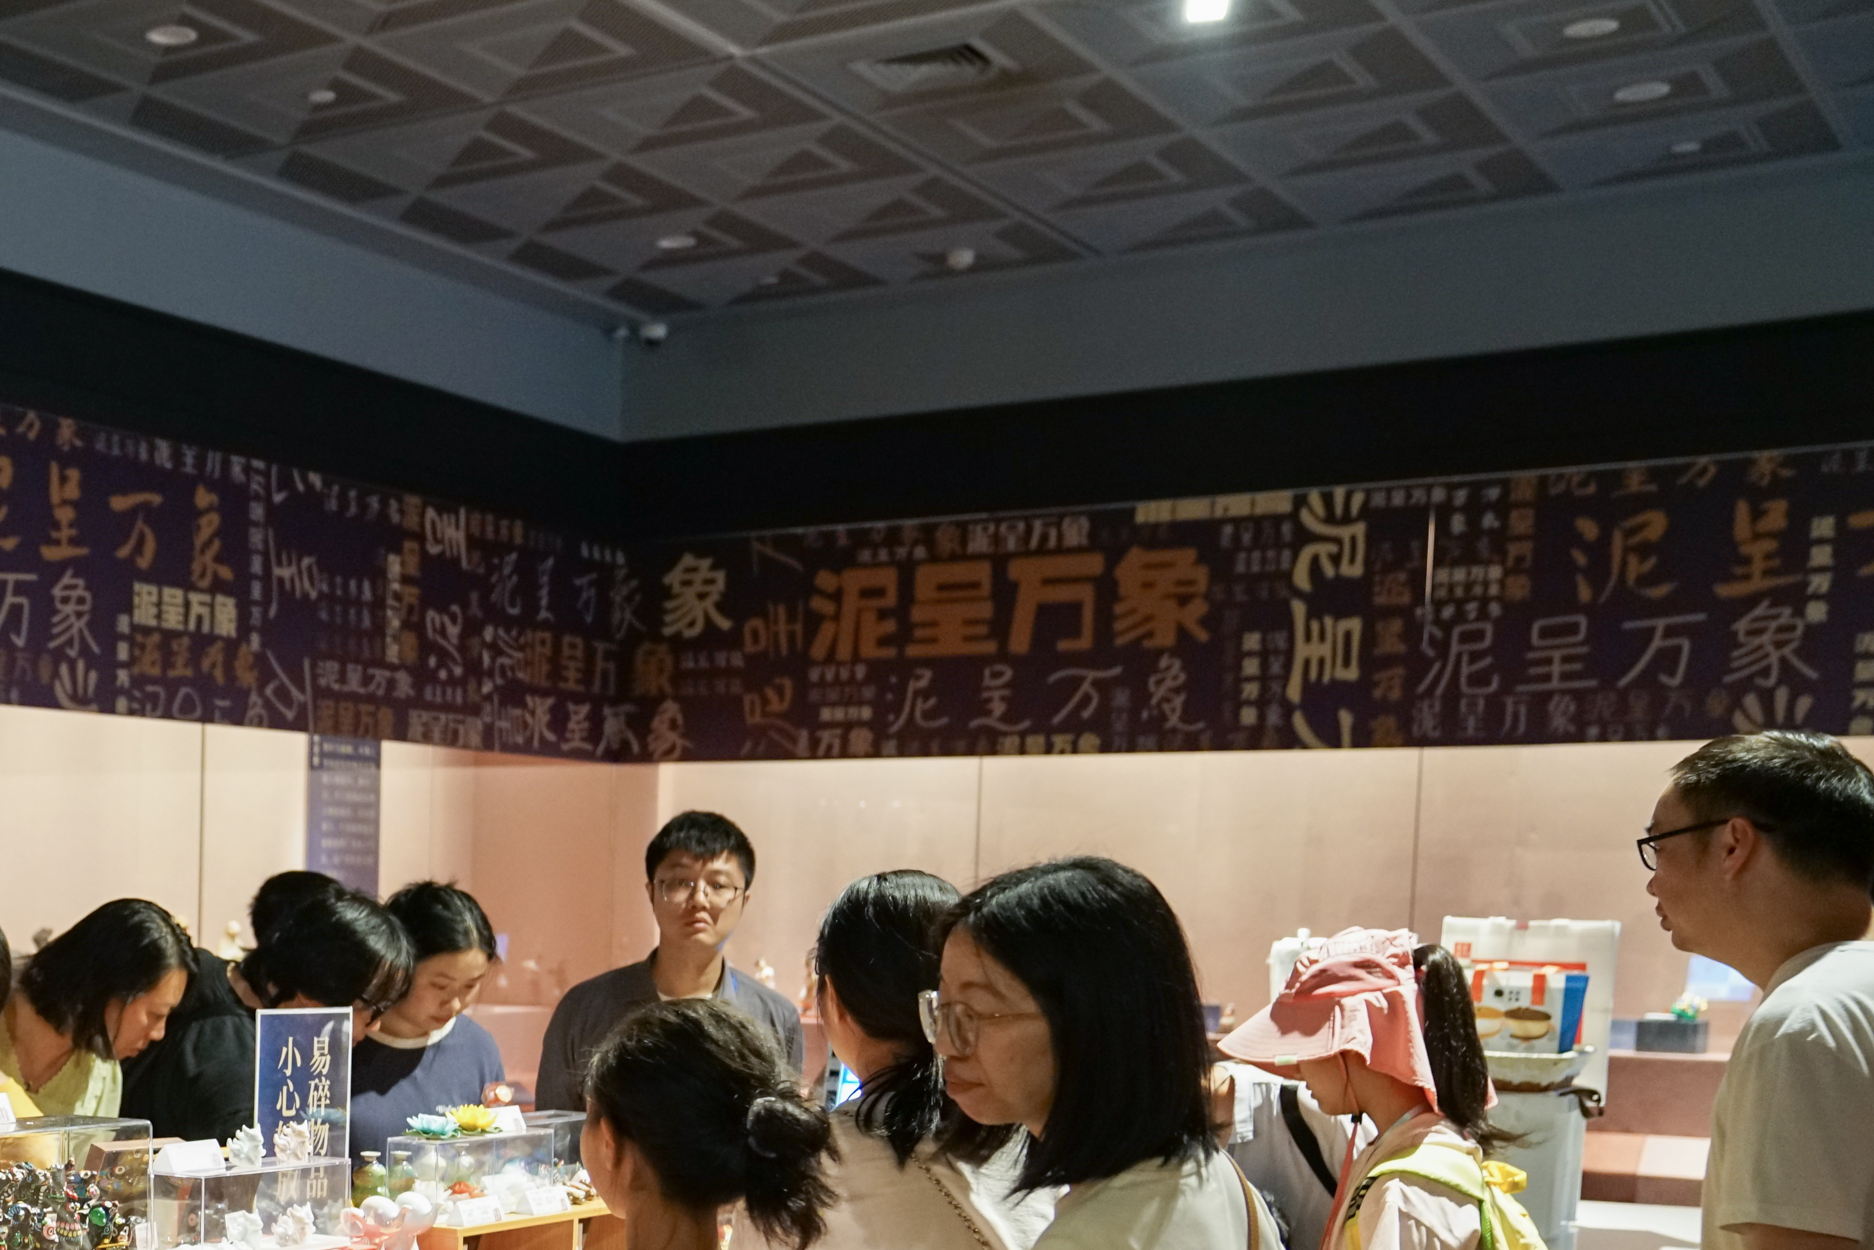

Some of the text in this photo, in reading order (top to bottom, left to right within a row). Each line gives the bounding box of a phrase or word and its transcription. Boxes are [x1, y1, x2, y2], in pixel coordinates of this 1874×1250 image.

[131, 579, 238, 638] 泥呈万象
[662, 552, 733, 639] 象
[809, 547, 1211, 663] 泥呈万象
[521, 629, 675, 696] 泥呈万象
[888, 653, 1207, 735] 泥呈万象
[1414, 598, 1819, 697] 泥呈万象
[276, 1036, 302, 1202] 小心放
[307, 1036, 332, 1199] 易碎物品
